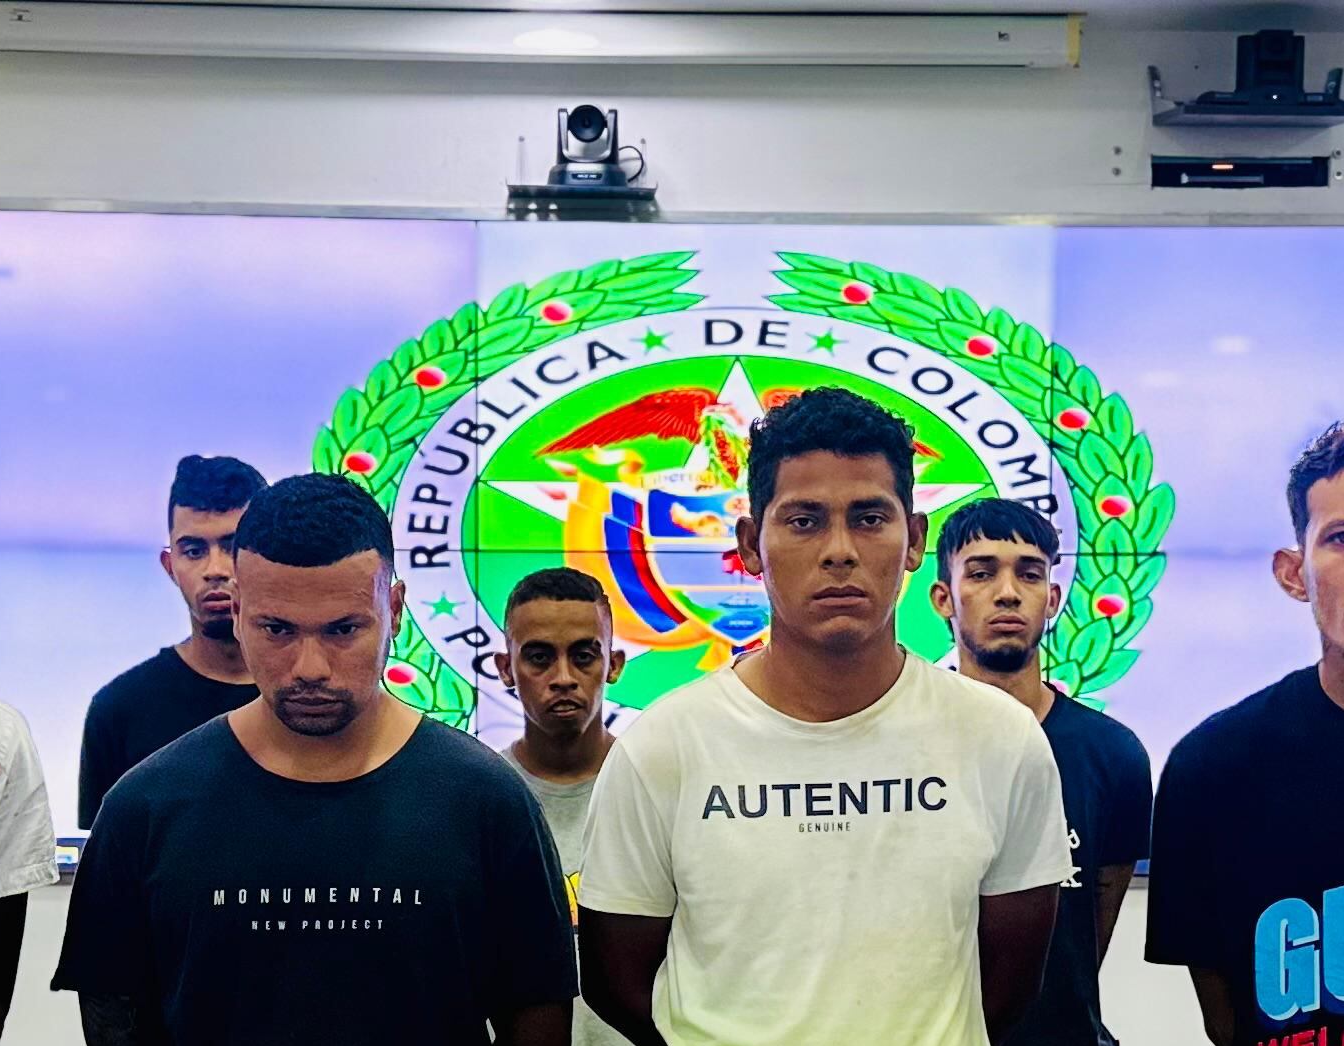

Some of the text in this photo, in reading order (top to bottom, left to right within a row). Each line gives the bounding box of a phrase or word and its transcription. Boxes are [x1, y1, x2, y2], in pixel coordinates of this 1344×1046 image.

[408, 318, 1061, 570] REPÚBLICA DE COLOMB
[702, 776, 947, 820] AUTENTIC
[799, 821, 851, 833] GENUINE
[213, 887, 422, 905] MONUMENTAL
[252, 919, 383, 931] NEW PROJECT
